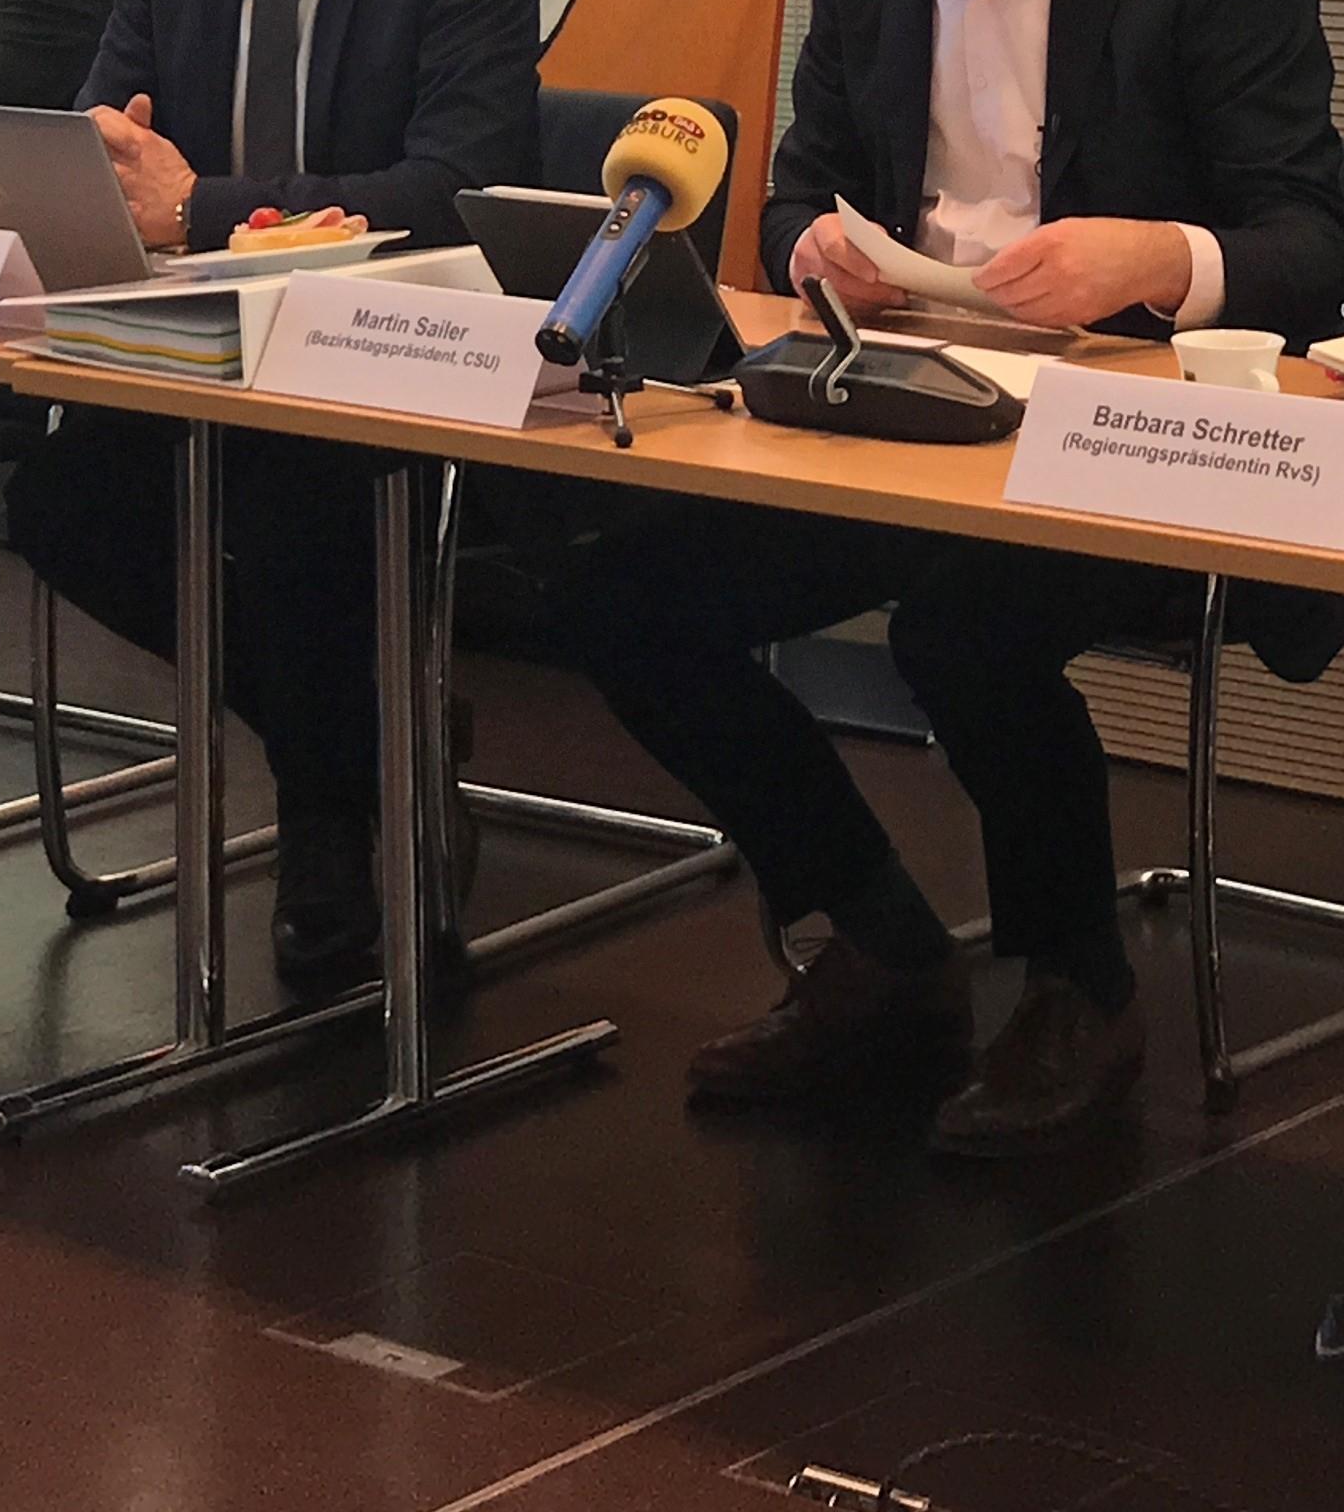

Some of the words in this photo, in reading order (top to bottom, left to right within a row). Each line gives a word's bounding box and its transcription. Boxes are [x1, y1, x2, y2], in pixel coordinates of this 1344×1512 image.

[351, 307, 411, 334] Martin
[414, 316, 470, 342] Sailer
[305, 329, 458, 365] (Bezirkstagspräsident,
[462, 351, 501, 374] CSU)
[1093, 405, 1185, 438] Barbara
[1192, 418, 1305, 454] Schretter
[1061, 431, 1270, 476] (Regierungspräsidentin
[1275, 460, 1320, 487] RvS)
